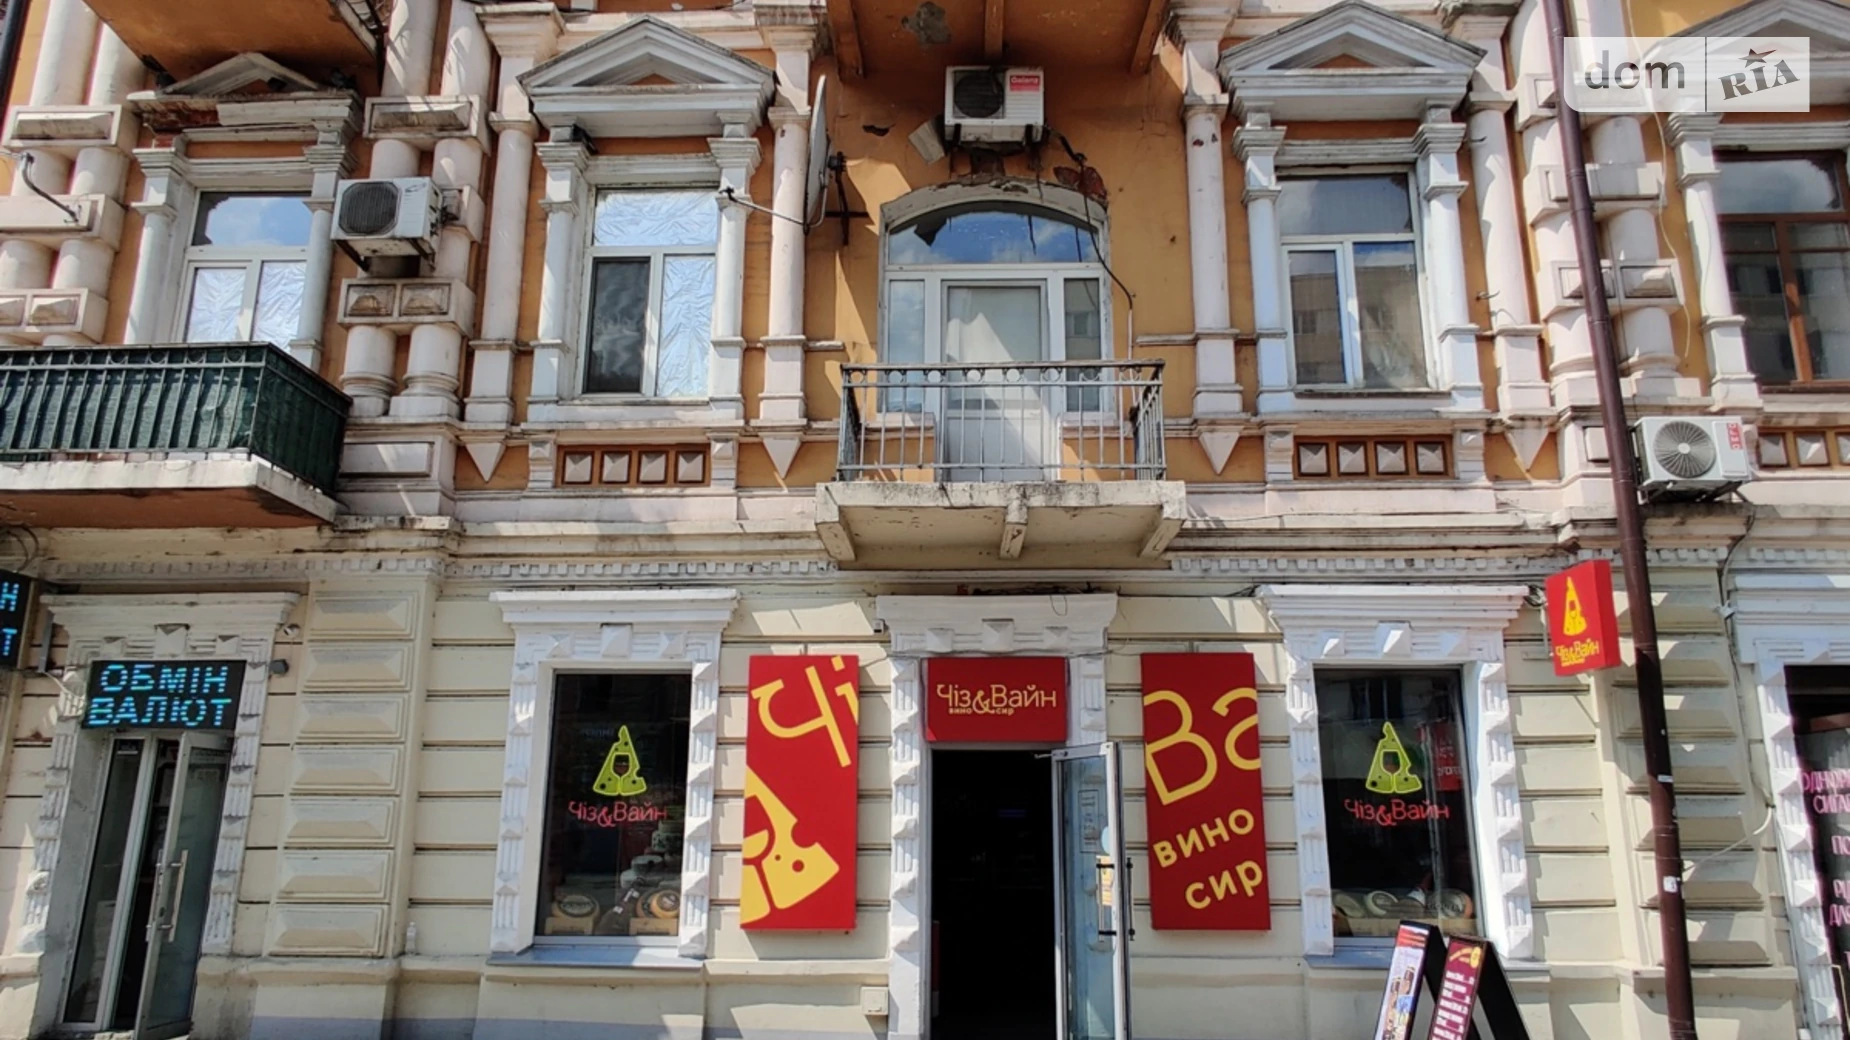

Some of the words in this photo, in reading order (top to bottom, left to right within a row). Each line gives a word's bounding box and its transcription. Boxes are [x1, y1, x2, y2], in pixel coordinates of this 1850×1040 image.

[100, 664, 229, 694] ОБМІН
[87, 696, 232, 727] ВАЛЮТ
[936, 684, 1057, 714] Чіз&Вайн
[948, 707, 973, 715] вино
[995, 707, 1015, 716] сир
[568, 801, 668, 827] Чіз&Вайн
[1344, 799, 1450, 826] Чіз&Вайн
[1153, 808, 1255, 868] вино
[1185, 859, 1263, 909] сир
